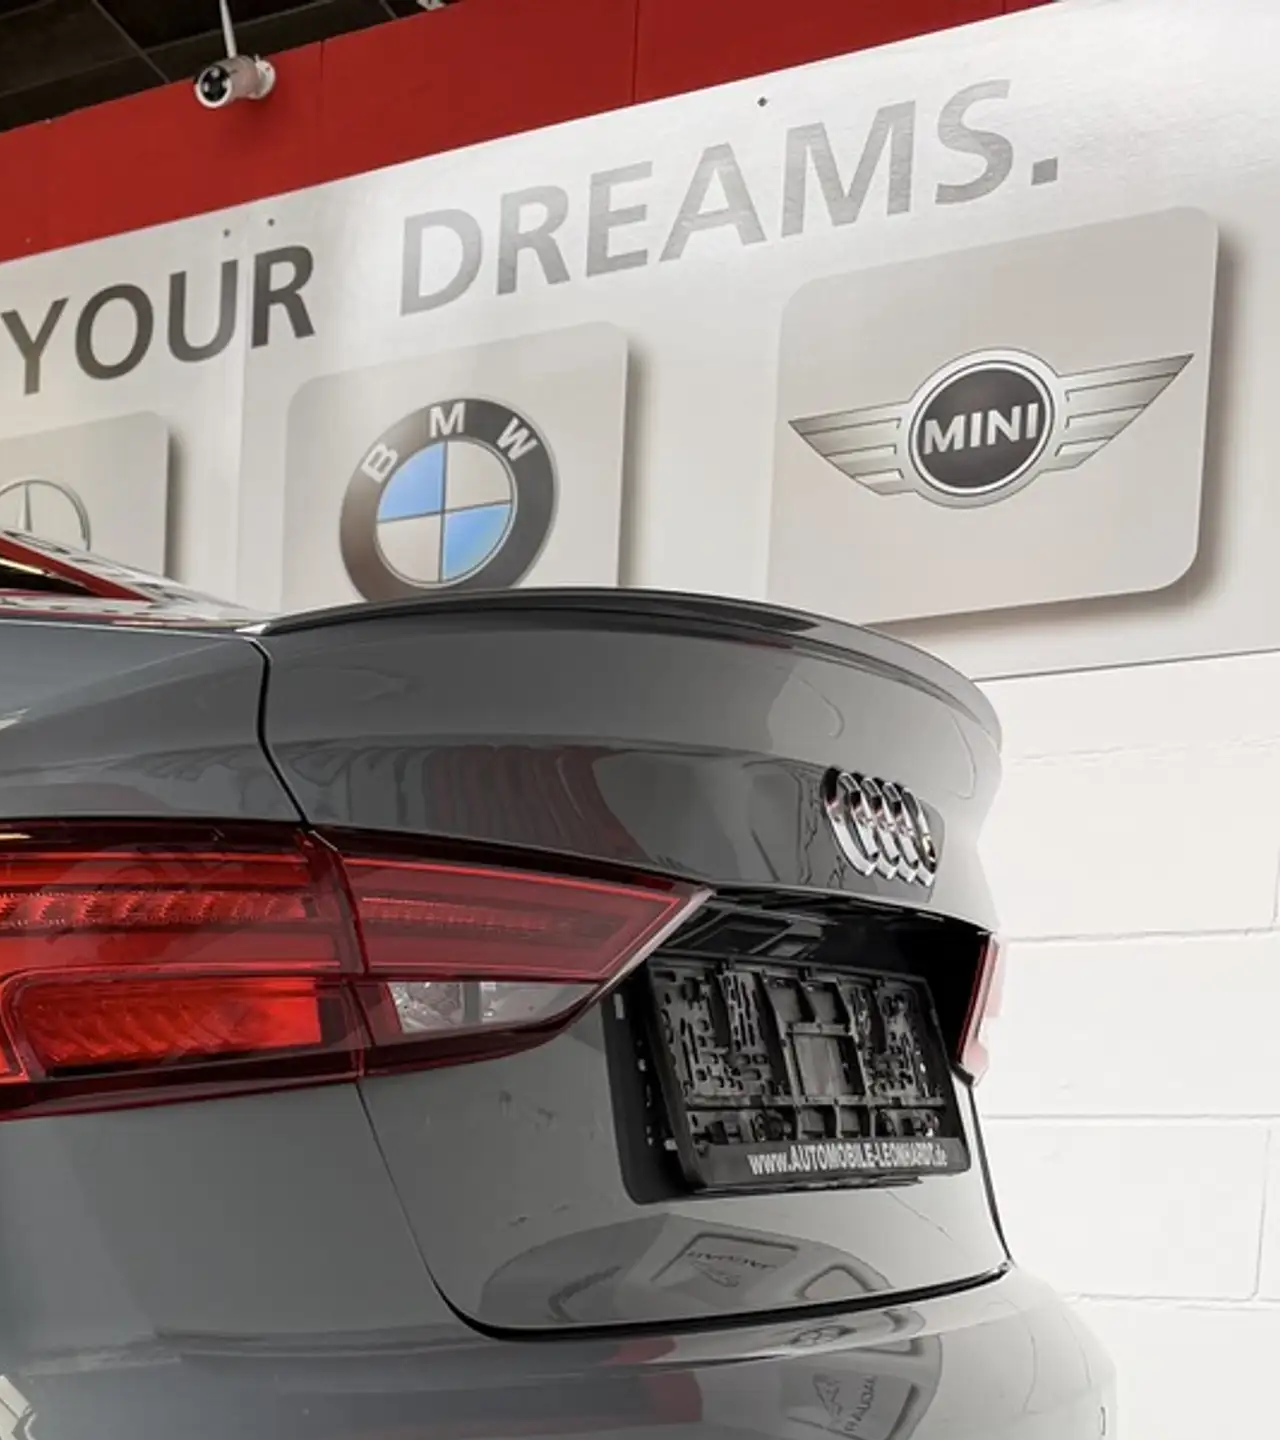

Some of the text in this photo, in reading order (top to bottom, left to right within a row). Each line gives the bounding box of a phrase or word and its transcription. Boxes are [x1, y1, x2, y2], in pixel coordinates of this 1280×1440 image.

[0, 245, 316, 397] YOUR
[399, 79, 1059, 316] DREAMS.
[360, 402, 538, 484] BMW
[923, 403, 1039, 455] MINI
